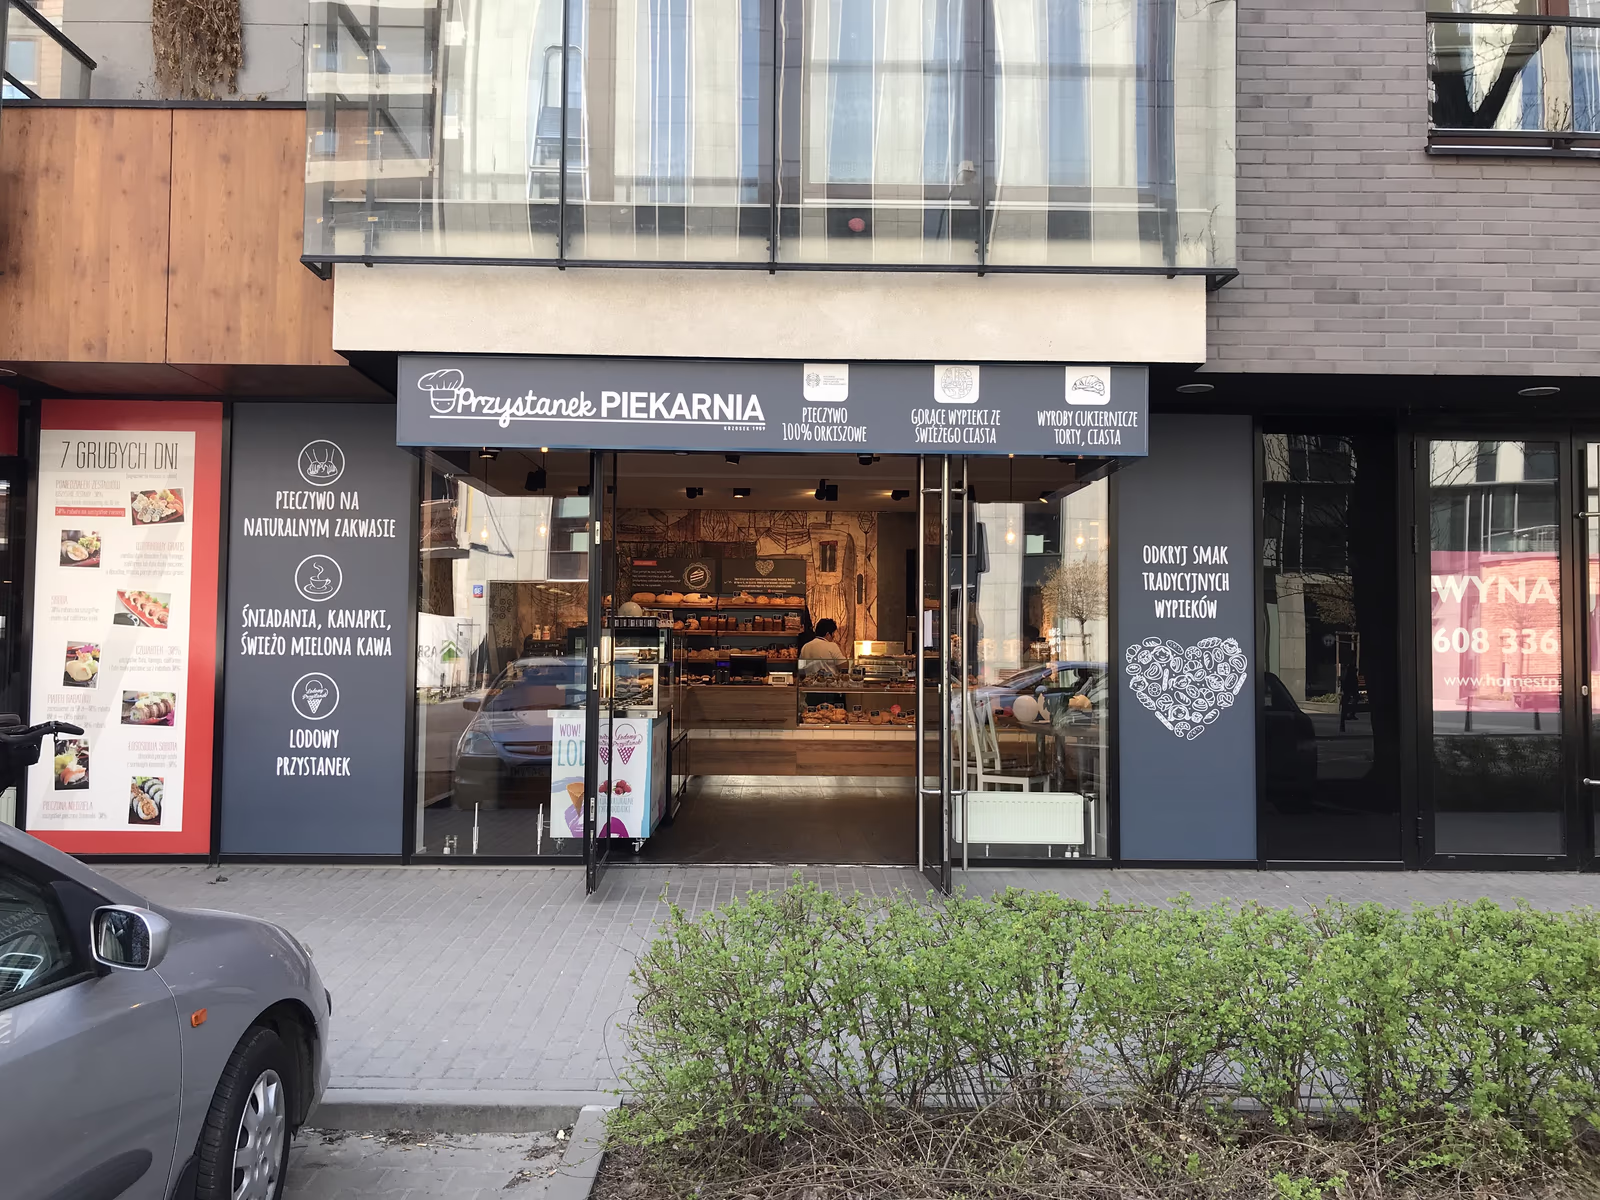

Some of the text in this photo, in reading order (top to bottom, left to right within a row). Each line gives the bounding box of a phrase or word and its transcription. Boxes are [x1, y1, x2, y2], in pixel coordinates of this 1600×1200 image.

[457, 387, 765, 428] Przystanek PIEKARNIA
[802, 407, 848, 424] PIECZYWO
[911, 409, 1001, 428] GORĄCE WYPIEKI ZE
[1037, 410, 1138, 428] WYROBY CUKIERNICZE
[782, 423, 867, 442] 100% ORKISZOWE
[915, 423, 997, 444] ŚWIEŻEGO CIASTA
[1054, 428, 1121, 446] TORTY, CIASTA
[61, 441, 178, 470] 7 GRUBYCH DNI
[275, 490, 359, 510] PIECZYWO NA
[243, 517, 396, 538] NATURALNYM ZAKWASIE
[1142, 544, 1229, 566] ODKRYJ SMAK
[1142, 572, 1230, 594] TRADYCYJNYCH
[241, 604, 392, 630] ŚNIADANIA, KANAPKI,
[1154, 595, 1218, 619] WYPIEKÓW
[241, 631, 392, 656] ŚWIEŻO MIELONA KAWA
[1433, 627, 1559, 655] 608 336
[289, 728, 339, 749] LODOWY
[560, 723, 581, 738] WOW!
[276, 756, 351, 777] PRZYSTANEK
